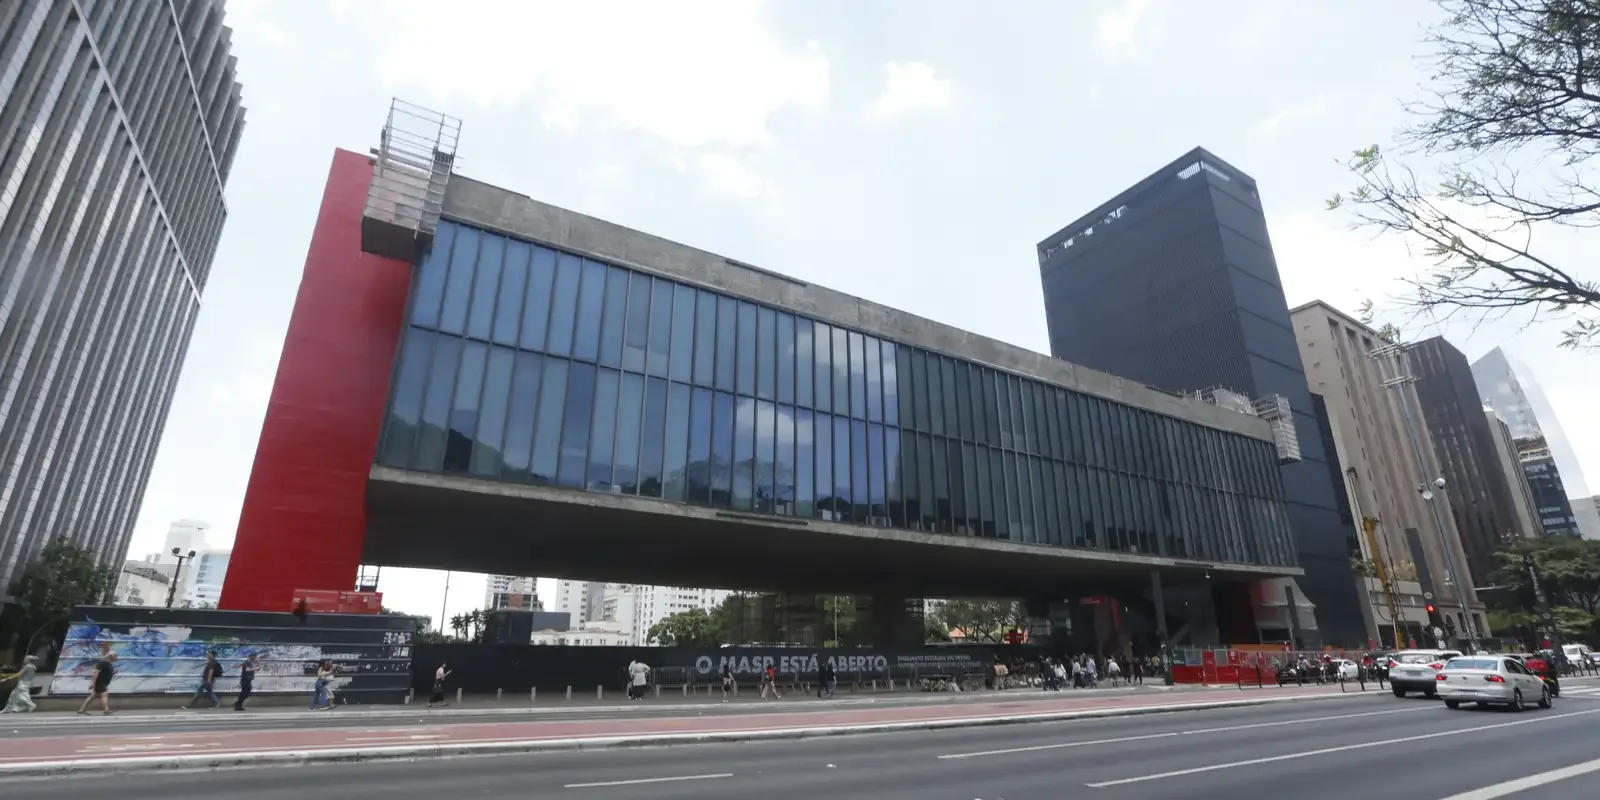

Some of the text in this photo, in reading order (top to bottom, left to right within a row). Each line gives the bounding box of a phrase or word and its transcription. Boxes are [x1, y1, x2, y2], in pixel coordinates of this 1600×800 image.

[696, 653, 888, 674] O MASP ESTÁ ABERTO
